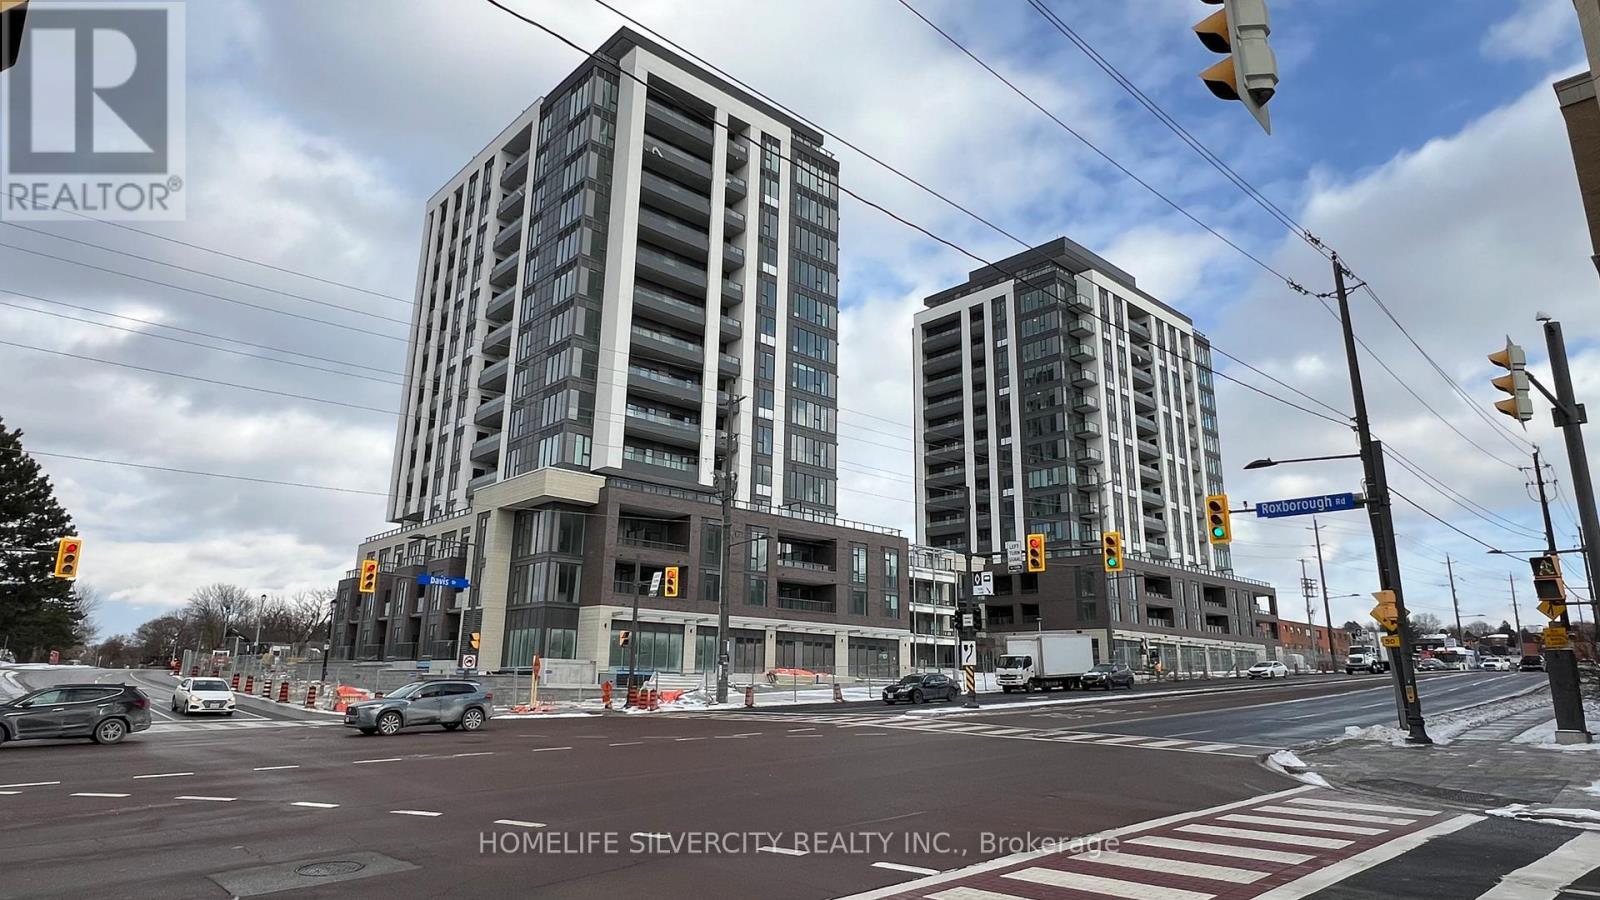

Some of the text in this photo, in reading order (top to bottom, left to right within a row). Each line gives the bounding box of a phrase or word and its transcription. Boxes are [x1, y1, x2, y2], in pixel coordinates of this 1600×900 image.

[1261, 496, 1346, 514] Roxborough Rd
[430, 575, 449, 586] Davis
